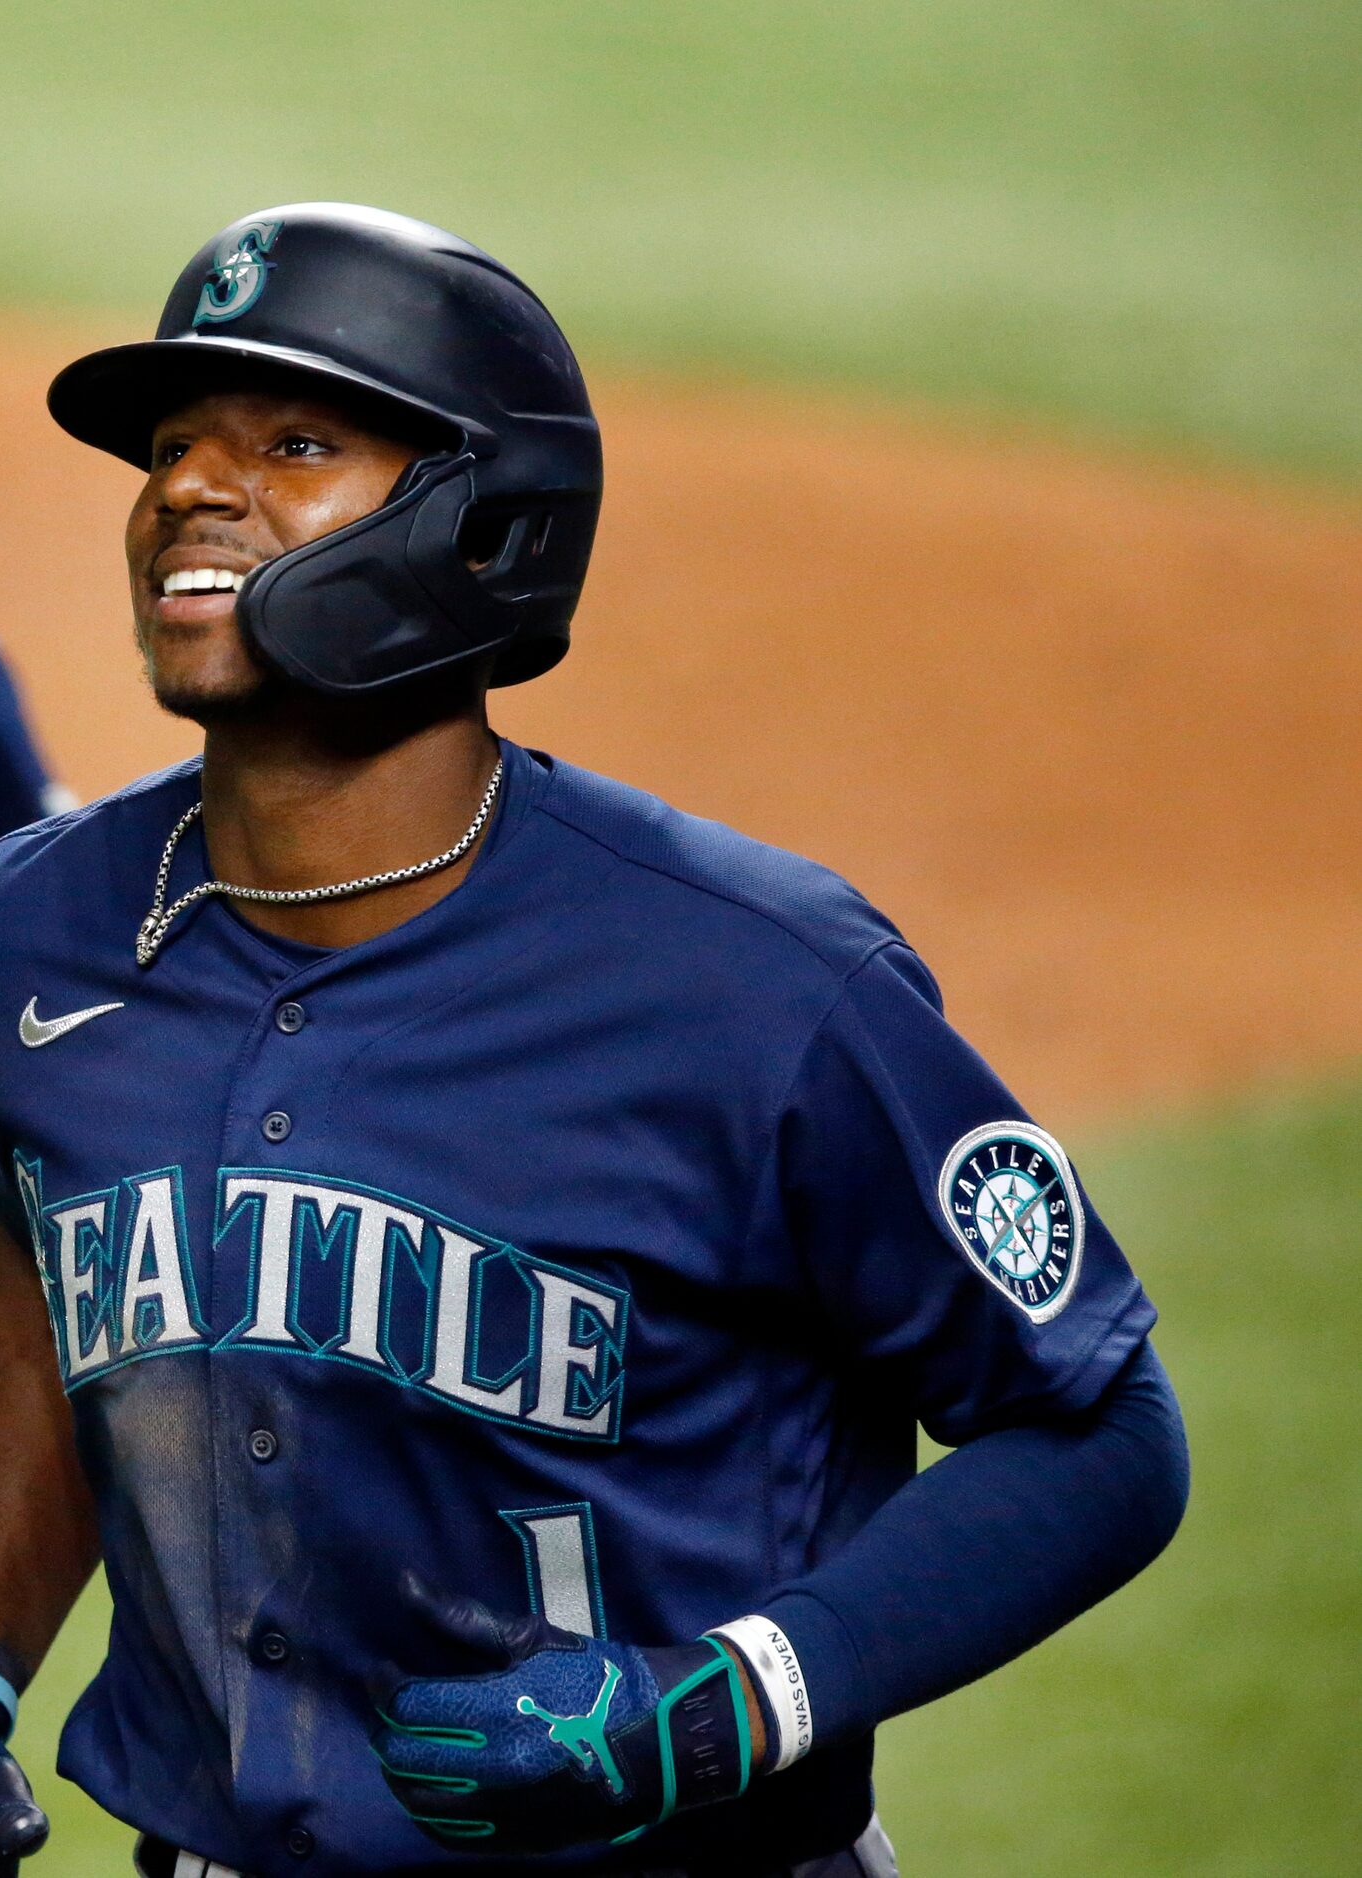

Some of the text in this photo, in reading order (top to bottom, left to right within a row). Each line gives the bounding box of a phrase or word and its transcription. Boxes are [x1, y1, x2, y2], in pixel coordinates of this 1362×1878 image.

[192, 221, 284, 329] S
[955, 1144, 1043, 1240] SEATTLE
[14, 1150, 629, 1444] EATTLE
[998, 1199, 1070, 1302] MARINERS
[504, 1504, 605, 1641] 1
[767, 1631, 799, 1685] GIVEN
[793, 1688, 809, 1731] WAS
